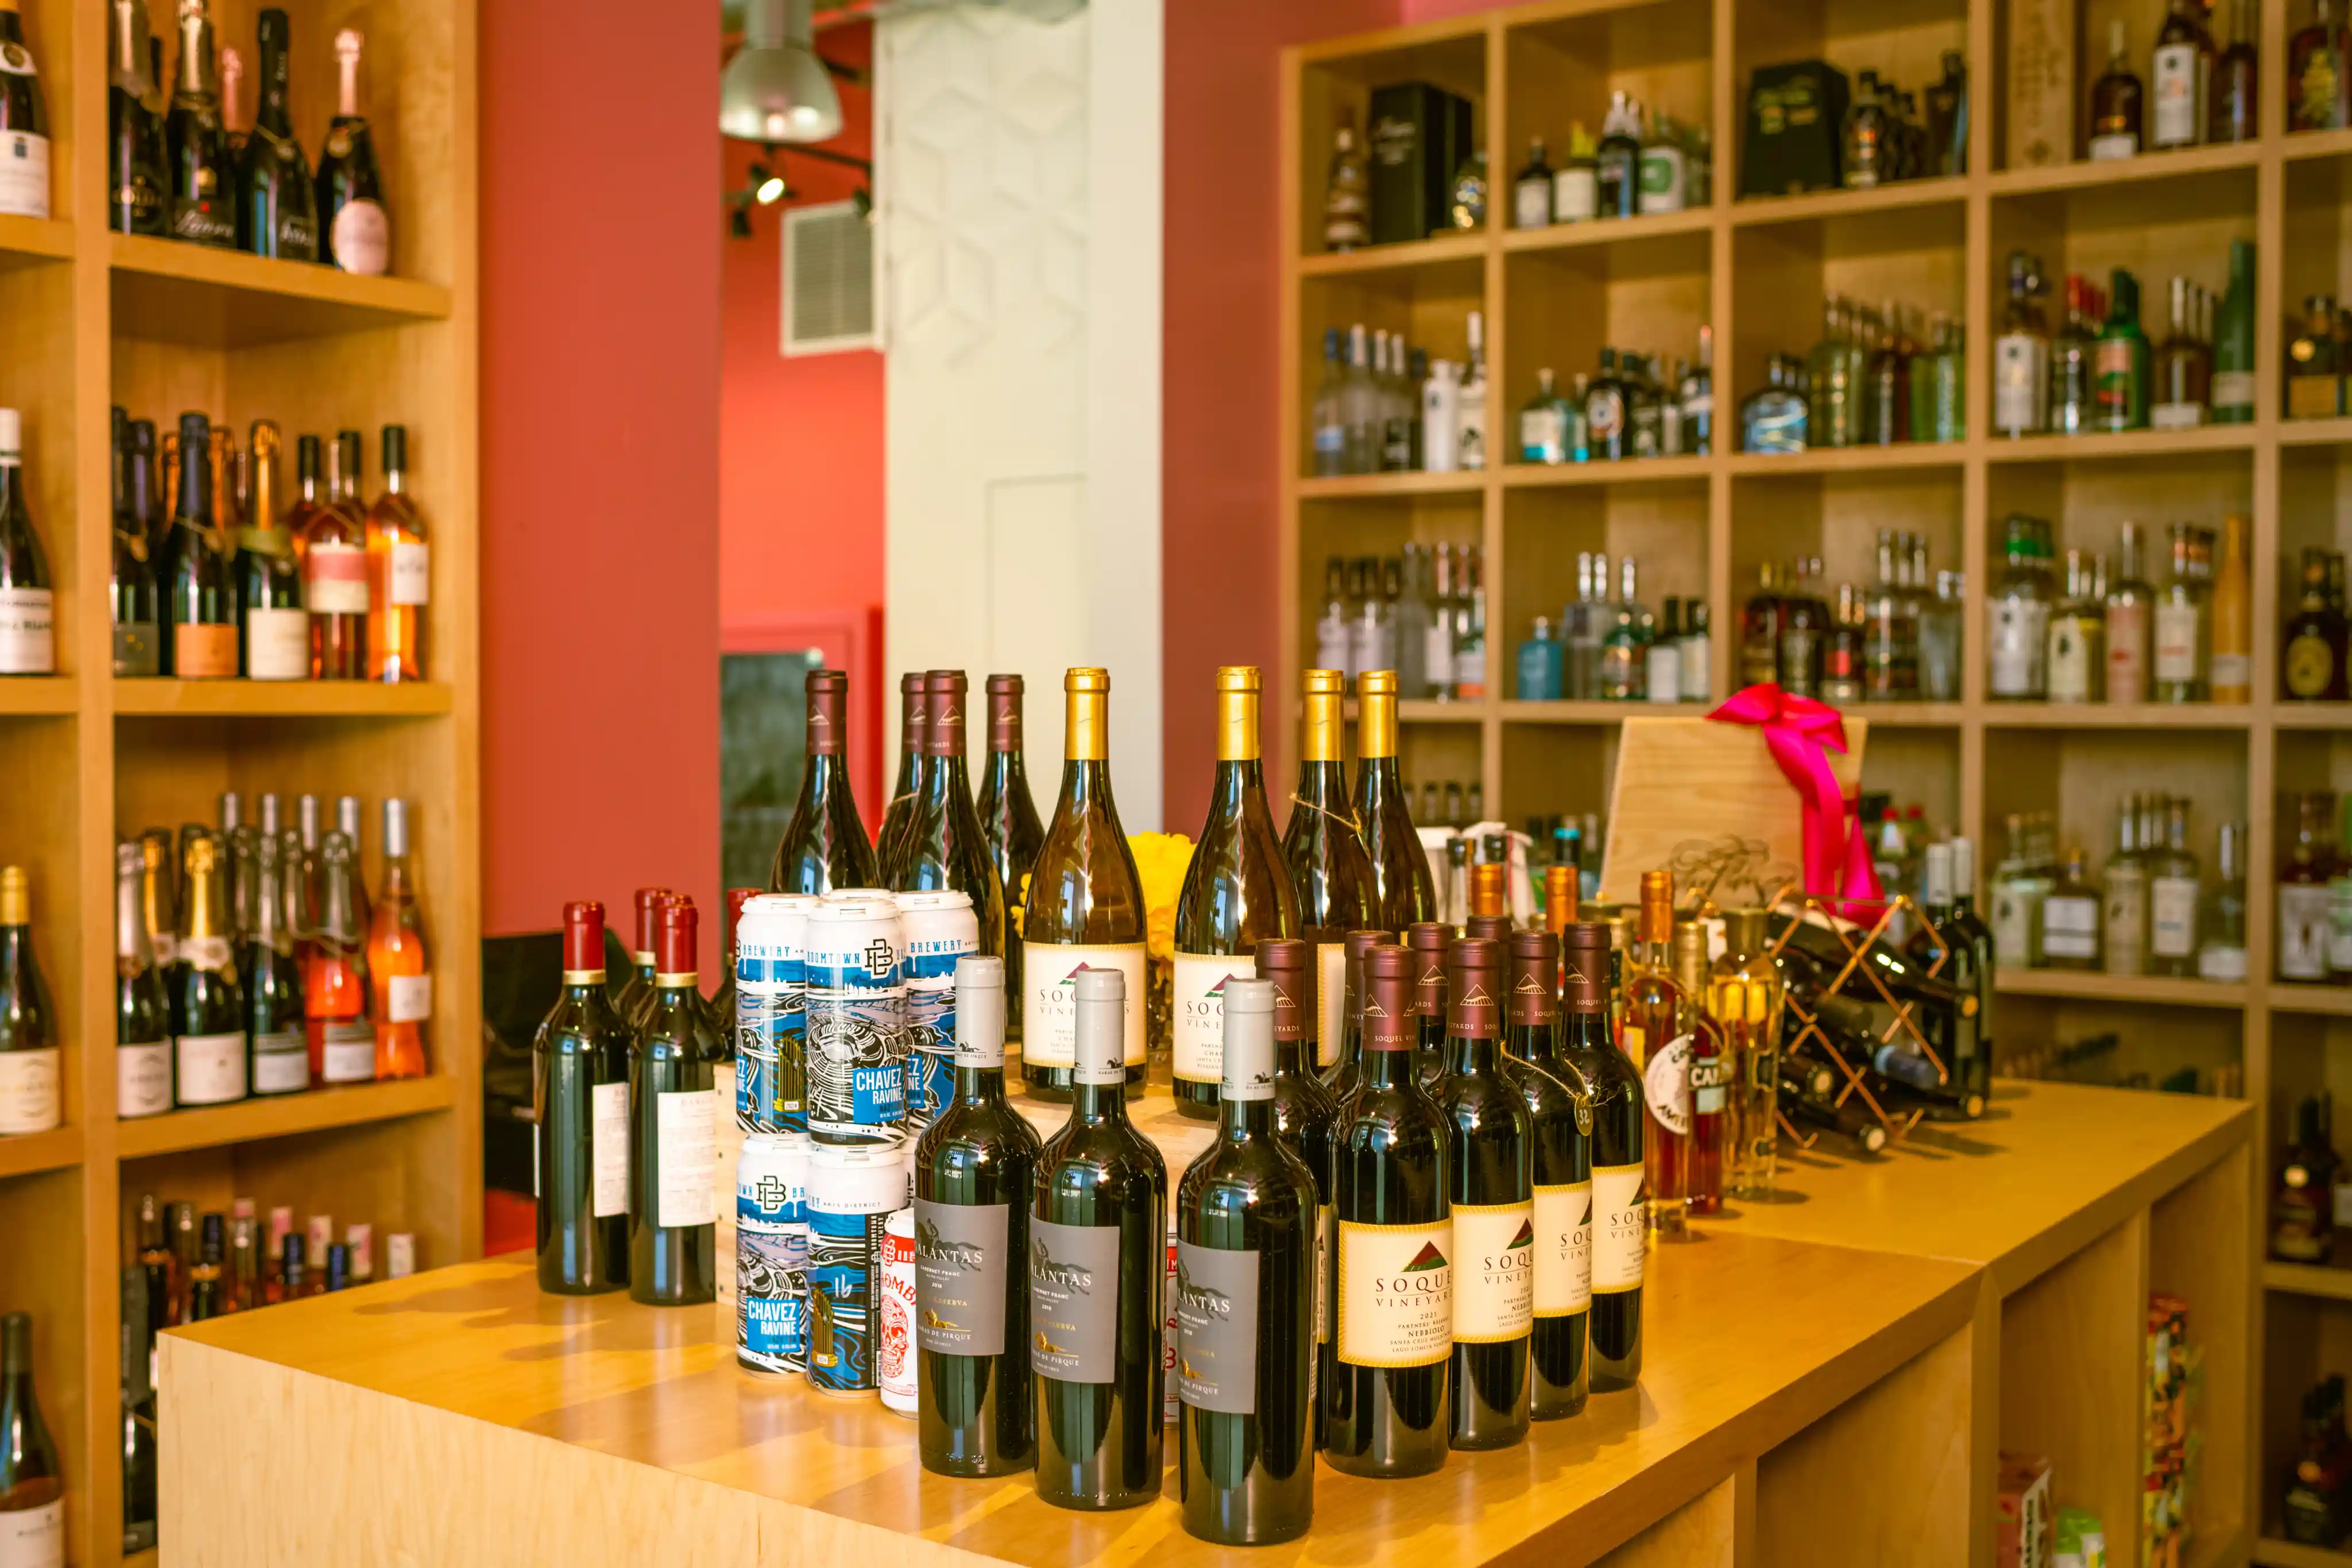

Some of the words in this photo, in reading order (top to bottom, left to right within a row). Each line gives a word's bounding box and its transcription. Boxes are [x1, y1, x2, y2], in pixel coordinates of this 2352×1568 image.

[743, 944, 790, 957] BREWERY
[910, 939, 962, 953] BREWERY
[807, 951, 860, 965] BOOMTOWN
[856, 1067, 902, 1091] CHAVEZ
[872, 1087, 902, 1105] RAVINE
[915, 1241, 983, 1264] ALANTAS
[942, 1269, 960, 1277] FRANC
[1051, 1291, 1069, 1300] FRANC
[748, 1300, 797, 1322] CHAVEZ
[1419, 1311, 1437, 1320] 2021
[760, 1321, 797, 1335] RAVINE
[1408, 1325, 1445, 1338] NEBBIOLO
[931, 1329, 940, 1337] DE
[942, 1331, 972, 1342] PIRQUE
[1051, 1355, 1080, 1367] PIRQUE
[1192, 1381, 1219, 1396] PIRQUE
